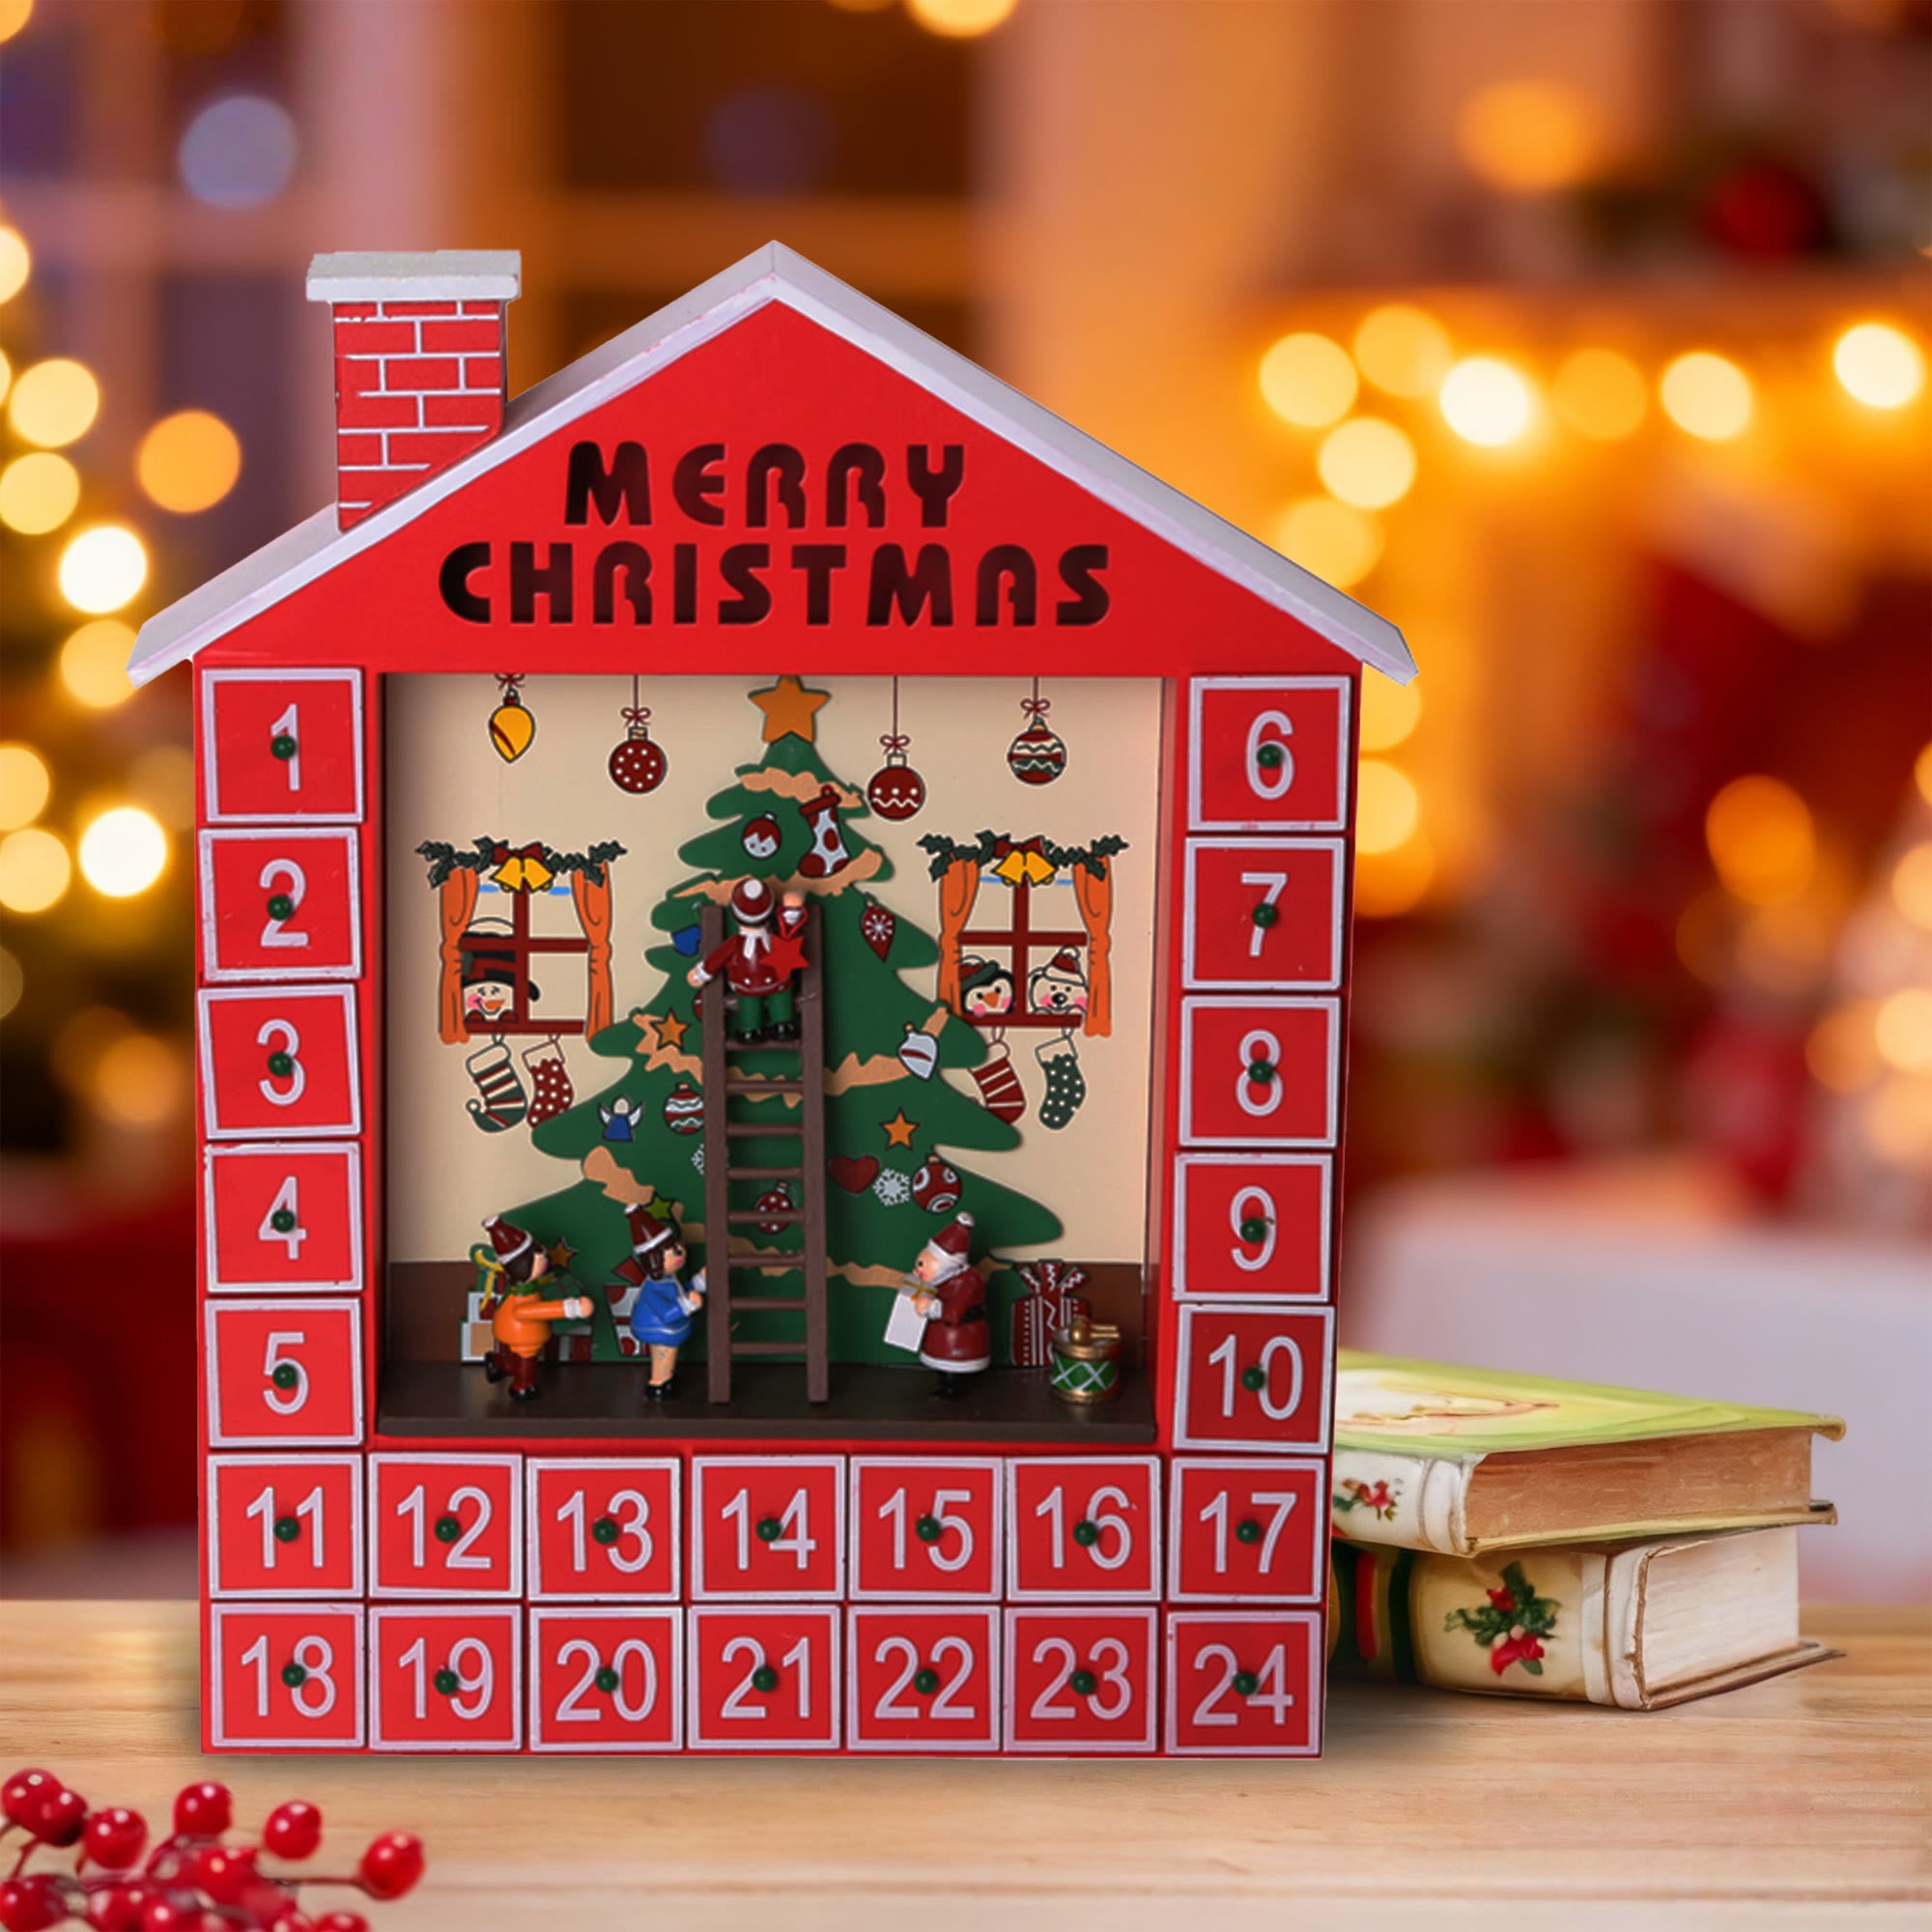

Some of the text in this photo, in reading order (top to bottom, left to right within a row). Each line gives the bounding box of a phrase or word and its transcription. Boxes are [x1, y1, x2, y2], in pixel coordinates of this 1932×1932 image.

[565, 440, 964, 528] MERRY
[439, 541, 1109, 627] CHRISTMAS
[270, 703, 300, 791] 1
[1246, 710, 1293, 800] 6
[259, 858, 309, 948] 2
[1241, 872, 1287, 956] 7
[257, 1018, 305, 1106] 3
[1236, 1030, 1283, 1117] 8
[258, 1176, 307, 1260] 4
[1230, 1186, 1276, 1271] 9
[263, 1331, 309, 1415] 5
[1208, 1334, 1302, 1420] 10
[246, 1486, 324, 1569] 11
[397, 1485, 492, 1570] 12
[556, 1490, 653, 1573] 13
[722, 1488, 816, 1570] 14
[878, 1488, 973, 1572] 15
[1037, 1486, 1131, 1570] 16
[1200, 1491, 1296, 1574] 17
[241, 1634, 336, 1718] 18
[399, 1637, 494, 1719] 19
[555, 1638, 657, 1721] 20
[721, 1636, 810, 1719] 21
[874, 1636, 975, 1719] 22
[1031, 1637, 1131, 1719] 23
[1193, 1644, 1293, 1724] 24
